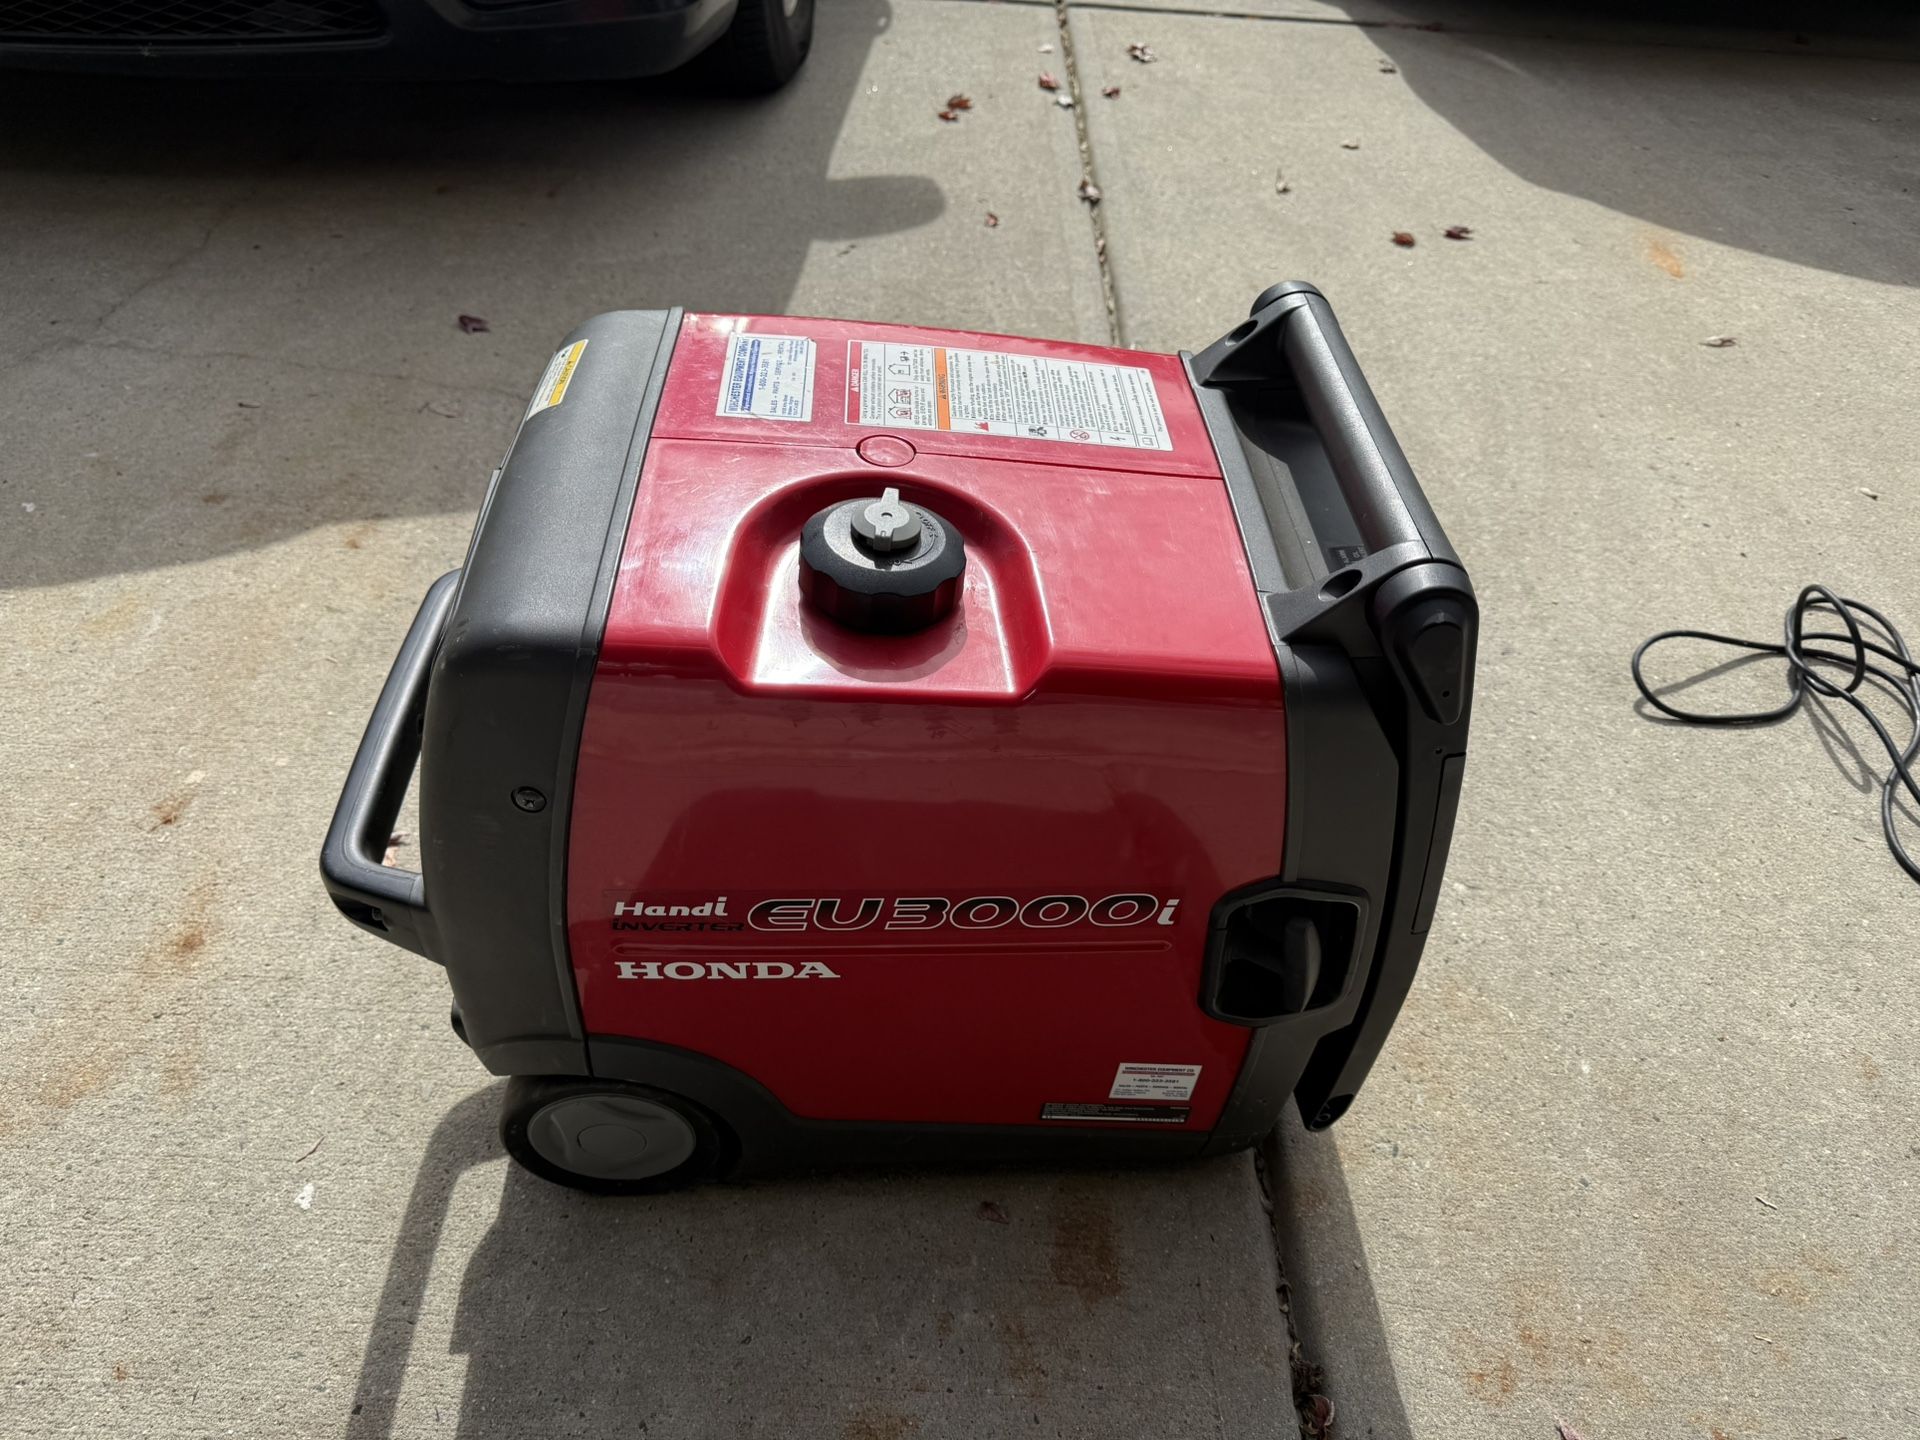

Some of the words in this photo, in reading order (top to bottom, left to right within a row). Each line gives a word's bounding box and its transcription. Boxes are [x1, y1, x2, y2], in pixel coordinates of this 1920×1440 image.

[850, 368, 859, 386] DANGER
[938, 374, 946, 393] WARNING
[614, 896, 728, 917] Handi
[747, 893, 1180, 931] EU3000i
[614, 961, 841, 980] HONDA
